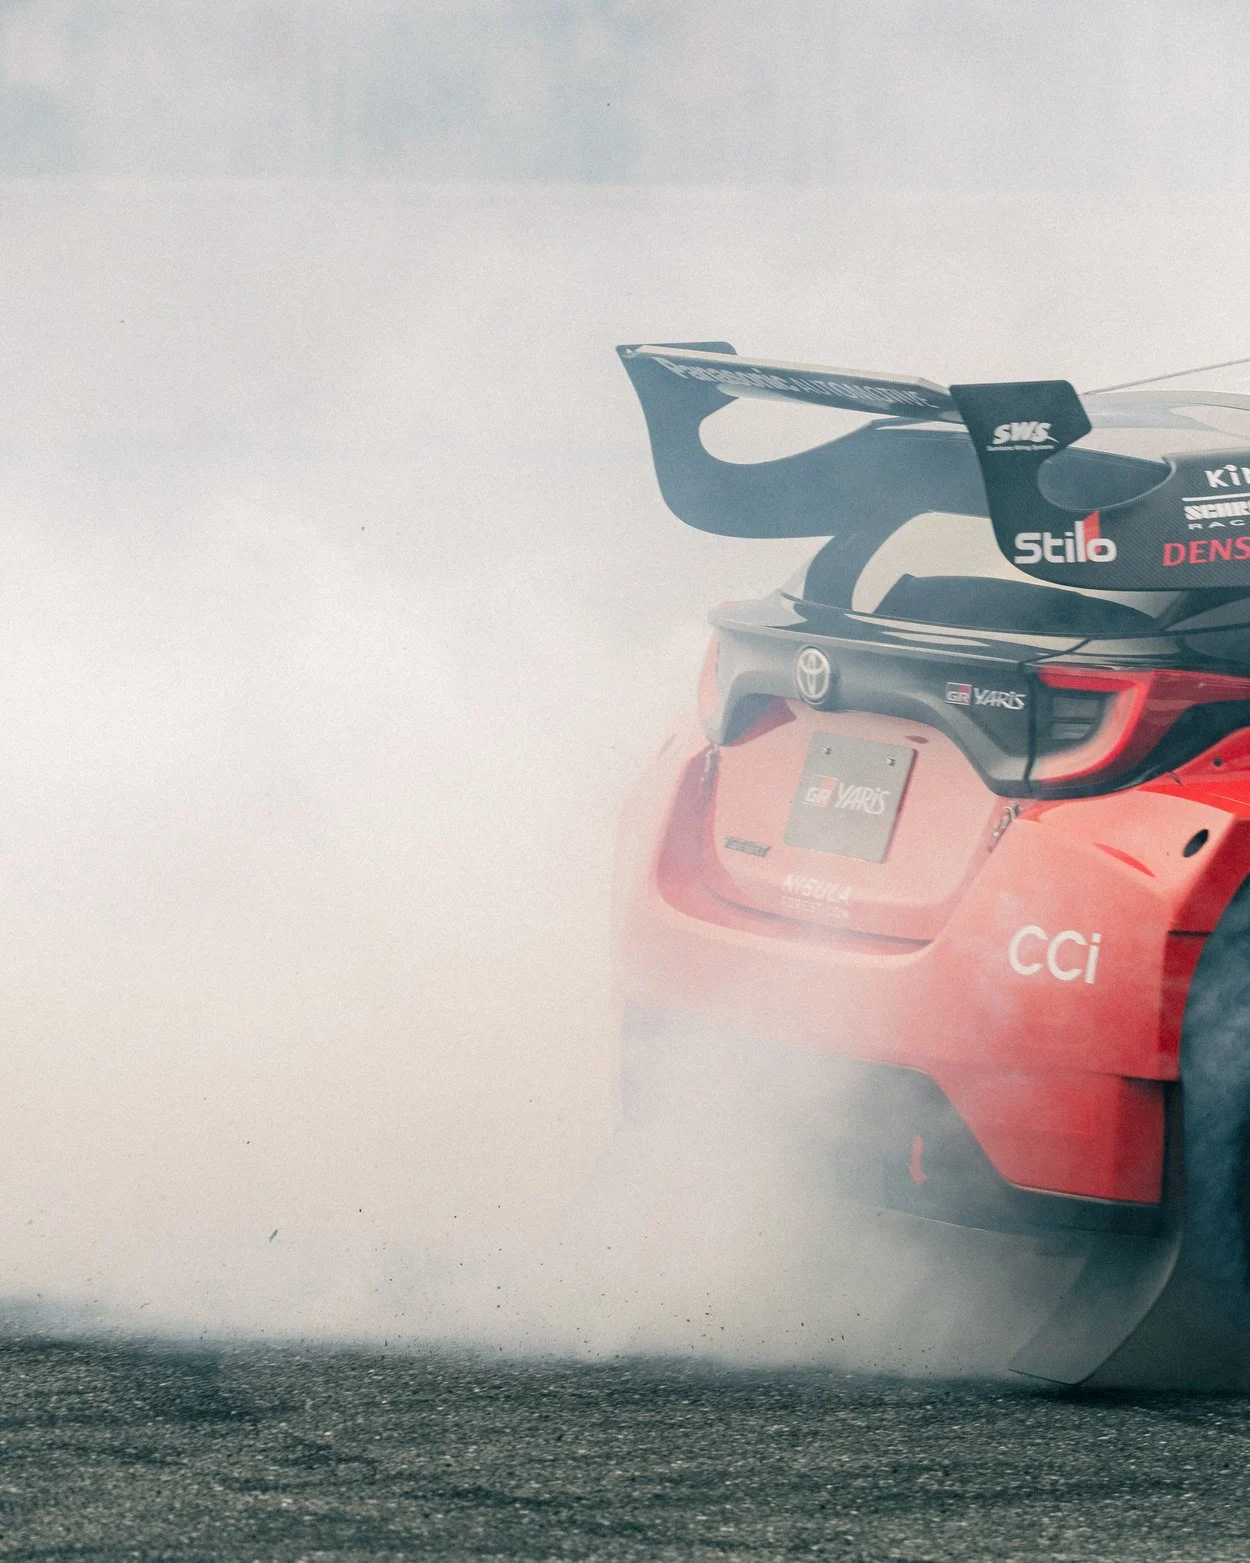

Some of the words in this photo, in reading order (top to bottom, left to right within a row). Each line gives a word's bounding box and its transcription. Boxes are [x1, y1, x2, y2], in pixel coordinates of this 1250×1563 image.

[651, 356, 800, 392] Panasonic
[992, 421, 1060, 445] SWS
[1014, 510, 1117, 564] Stilo
[1009, 924, 1102, 984] CCi
